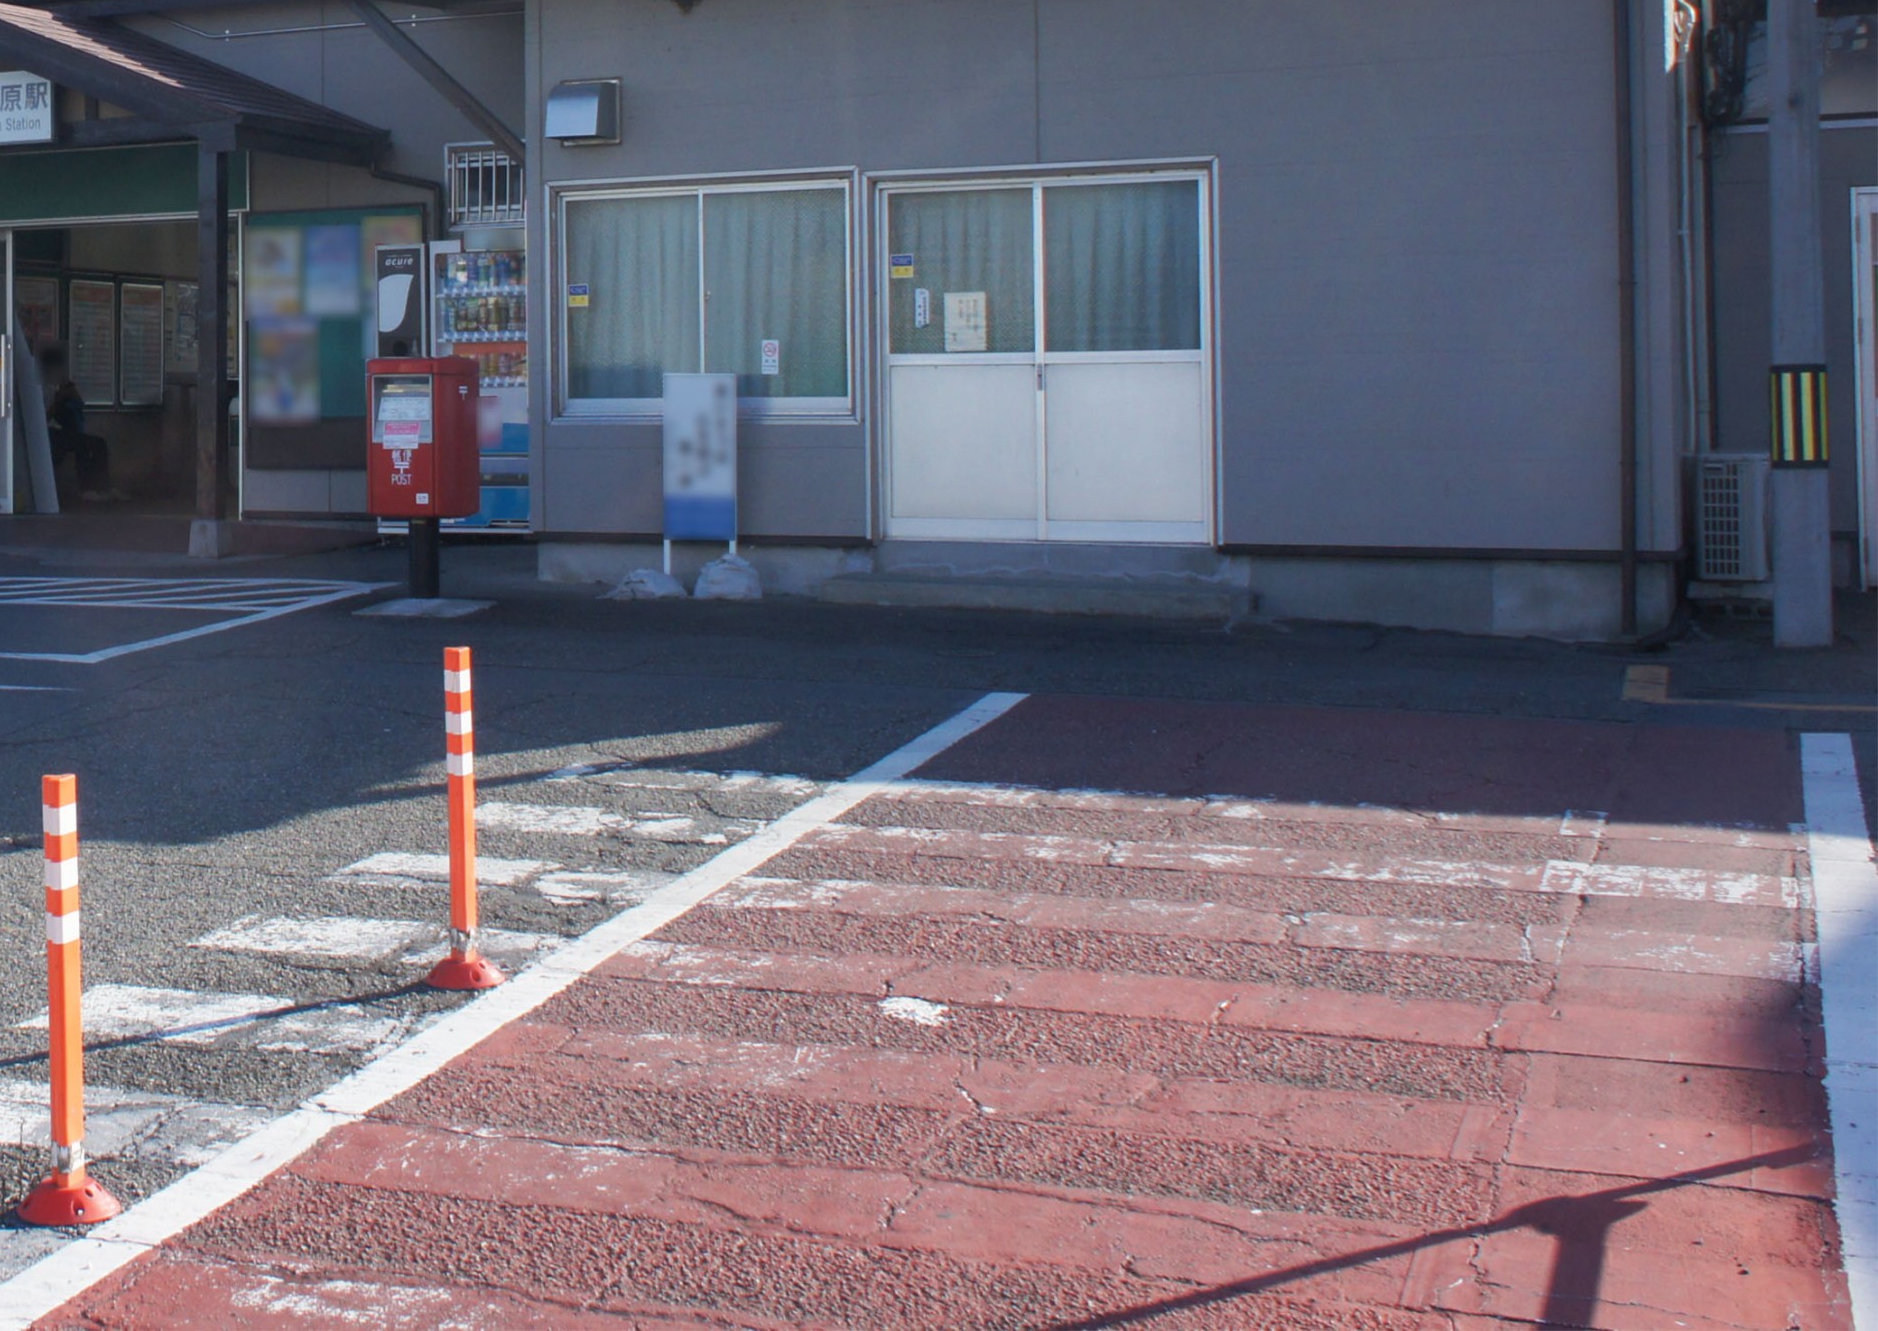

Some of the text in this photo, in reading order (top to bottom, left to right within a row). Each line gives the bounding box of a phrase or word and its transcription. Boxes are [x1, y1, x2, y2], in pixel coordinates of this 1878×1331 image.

[6, 118, 41, 131] Station
[384, 257, 414, 267] acure
[391, 473, 413, 485] POST
